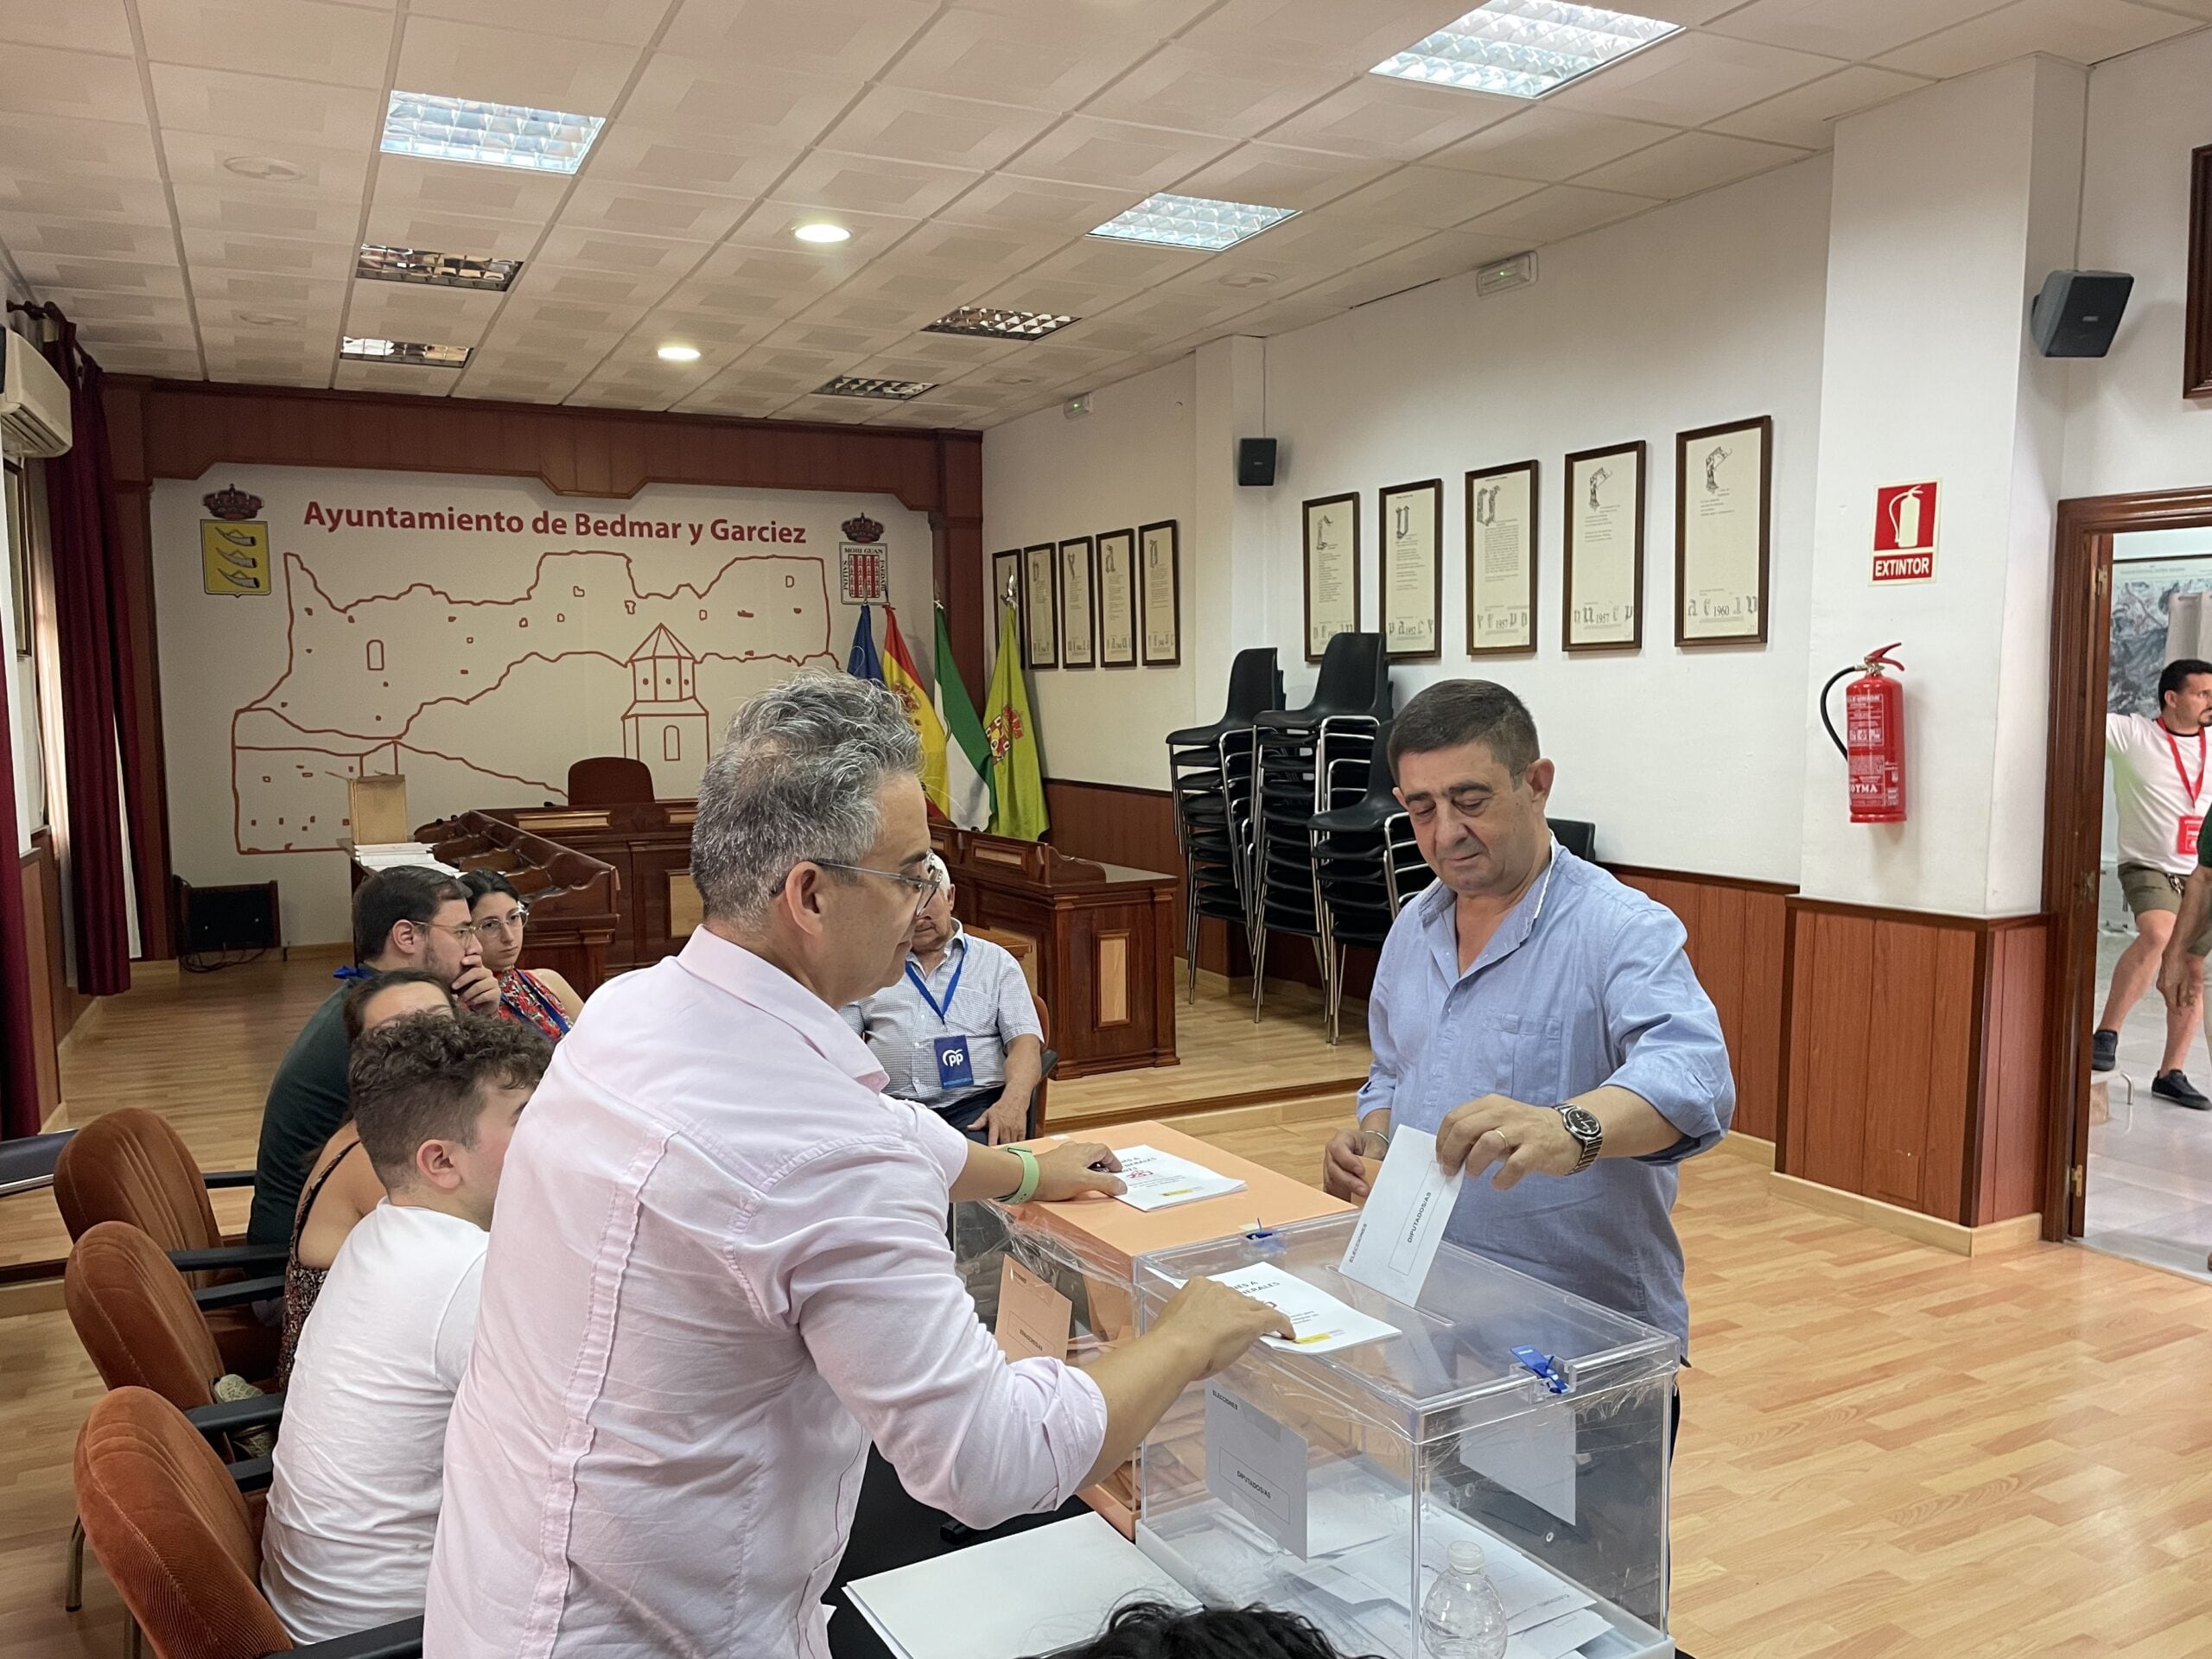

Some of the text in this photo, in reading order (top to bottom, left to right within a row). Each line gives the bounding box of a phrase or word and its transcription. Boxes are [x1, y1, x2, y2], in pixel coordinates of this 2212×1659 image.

[304, 501, 807, 545] Ayuntamiento de Bedmar y Garciez
[1874, 557, 1929, 577] EXTINTOR
[1596, 613, 1610, 624] 1957
[1713, 605, 1730, 617] 1960
[1407, 1192, 1432, 1243] DIPUTADOS/AS
[1349, 1223, 1368, 1263] ELECCIONES
[1236, 1470, 1271, 1499] DIPUTADOS/AS
